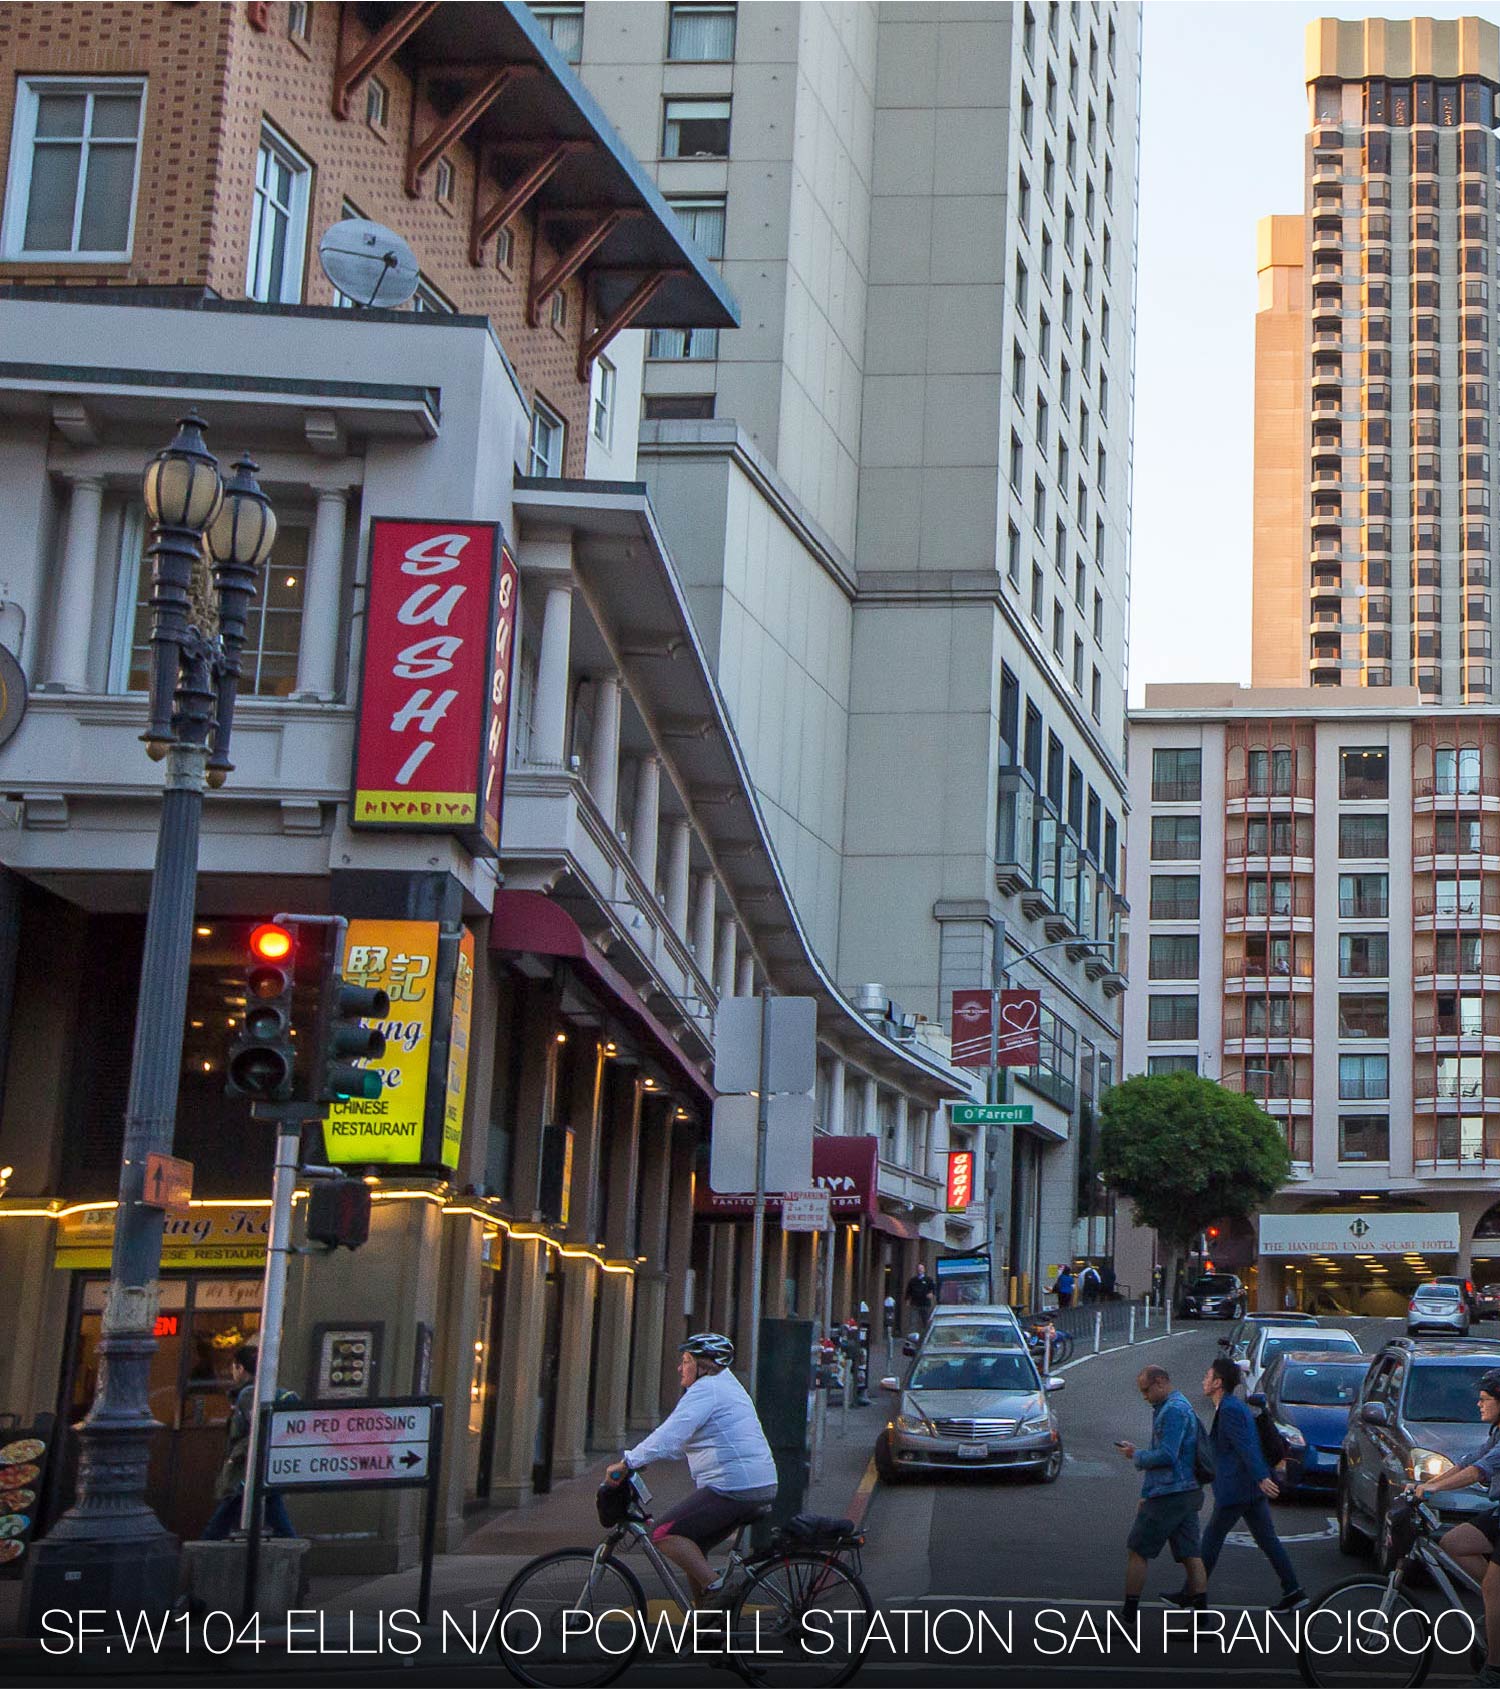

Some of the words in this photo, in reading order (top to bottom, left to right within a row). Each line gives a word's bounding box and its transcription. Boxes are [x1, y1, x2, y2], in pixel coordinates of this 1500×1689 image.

[389, 533, 471, 786] SUSHI
[334, 1101, 389, 1115] CHINESE
[964, 1109, 1023, 1119] O'Farrell
[331, 1121, 418, 1137] RESTAURANT
[162, 1215, 212, 1240] ing
[1264, 1242, 1283, 1251] THE
[1288, 1242, 1338, 1250] HANDLERY
[1343, 1242, 1375, 1250] UNION
[1381, 1242, 1416, 1250] SQUARE
[1422, 1241, 1456, 1249] HOTEL
[286, 1420, 306, 1434] NO
[313, 1418, 340, 1432] PED
[347, 1416, 416, 1432] CROSSING
[272, 1459, 300, 1474] USE
[310, 1455, 396, 1472] CROSSWALK
